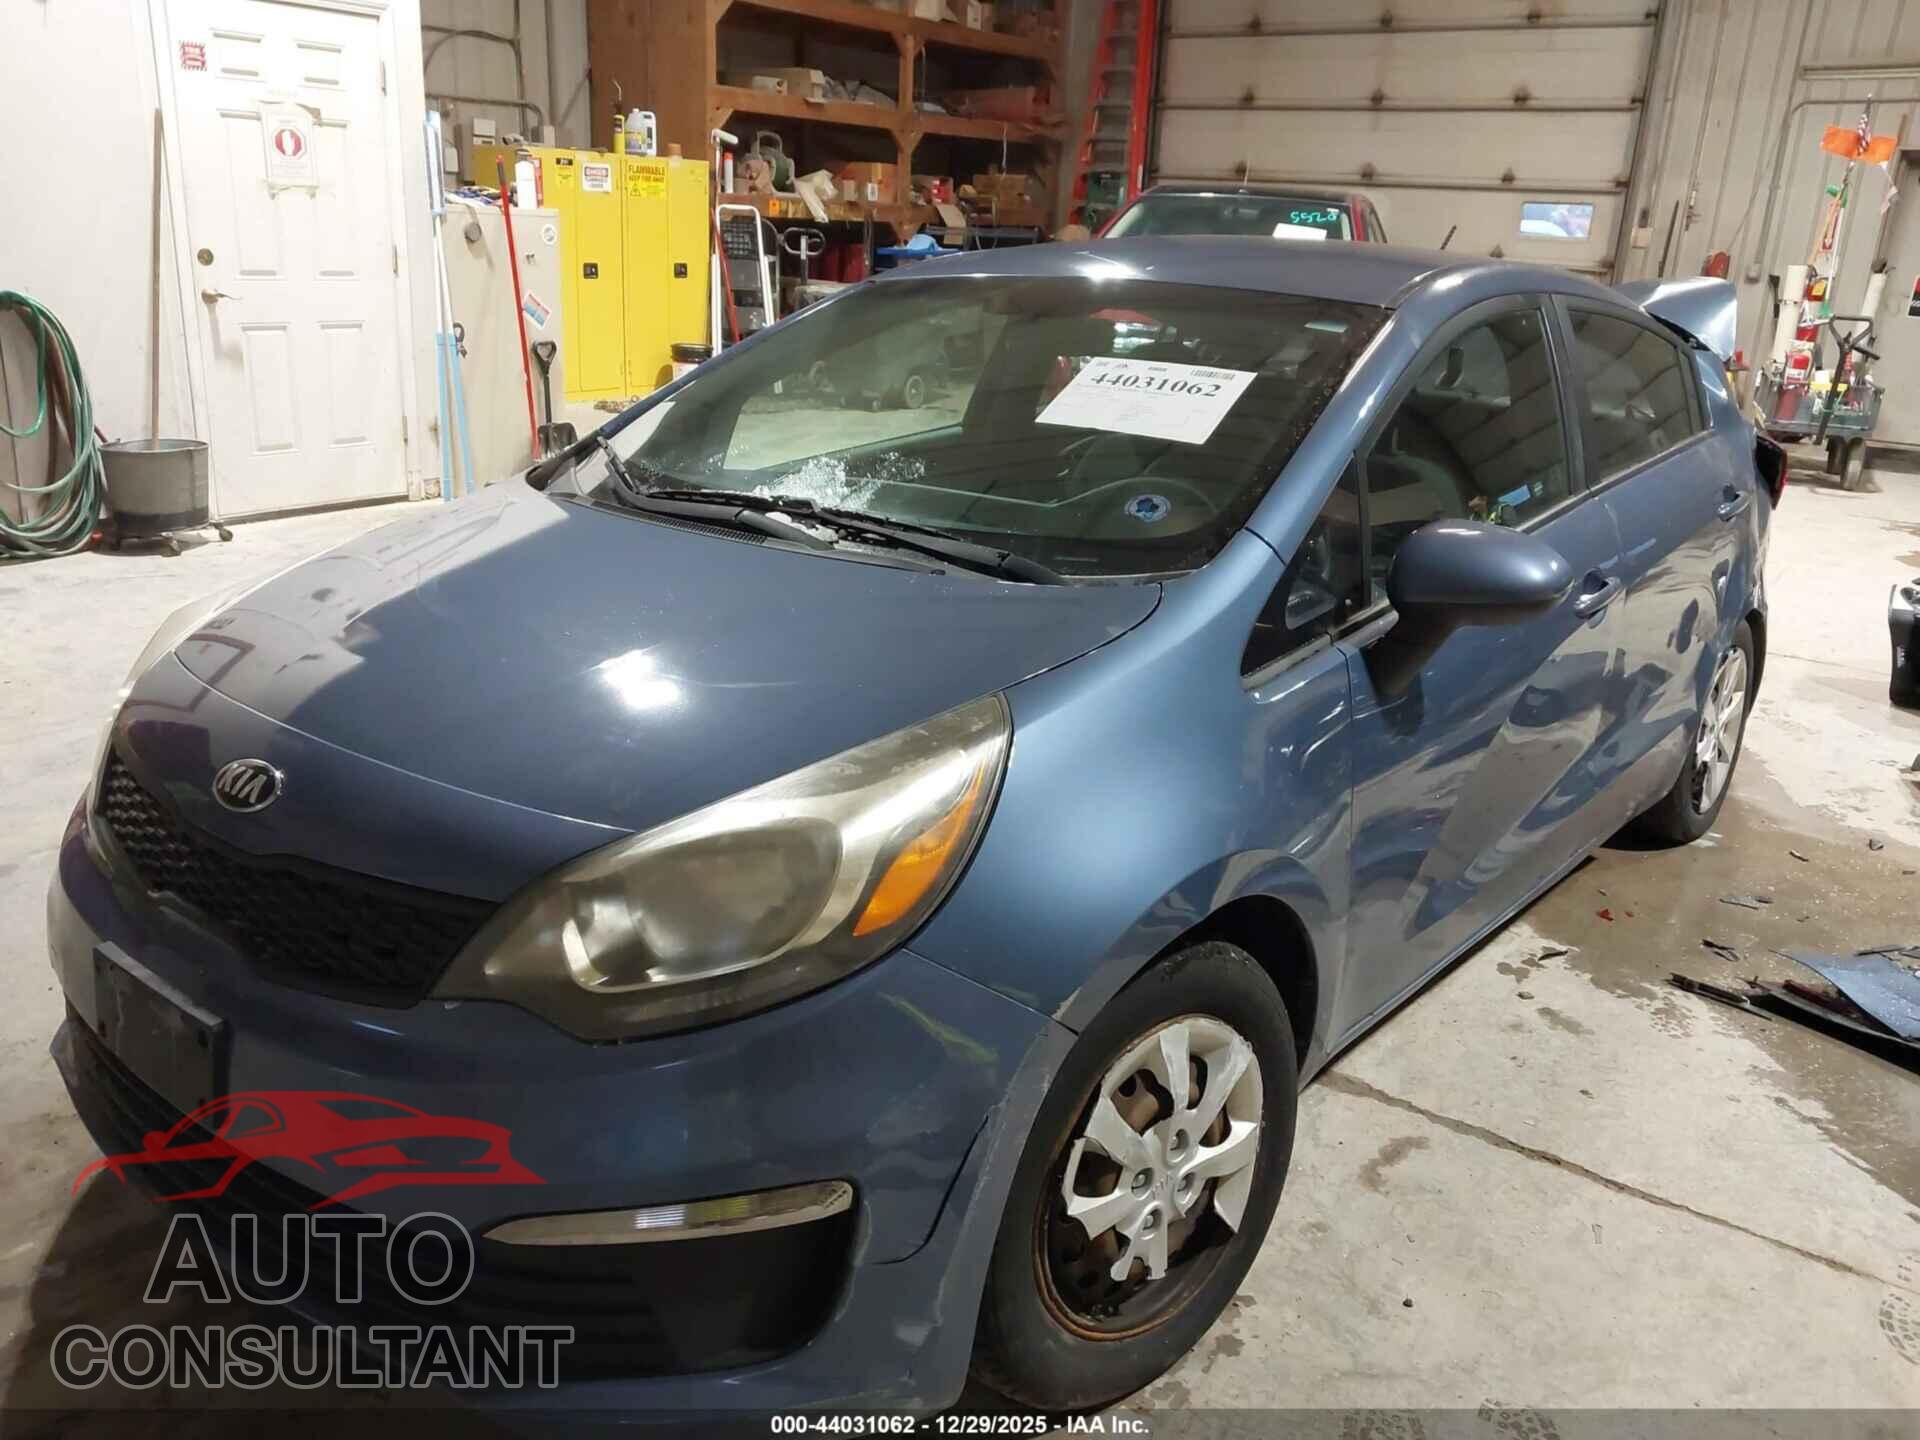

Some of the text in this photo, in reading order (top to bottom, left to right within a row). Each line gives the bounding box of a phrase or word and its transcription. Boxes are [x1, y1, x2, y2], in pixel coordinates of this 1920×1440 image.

[628, 164, 666, 177] FLAMMABLE
[1091, 372, 1222, 397] 44031062
[216, 764, 269, 805] KIA
